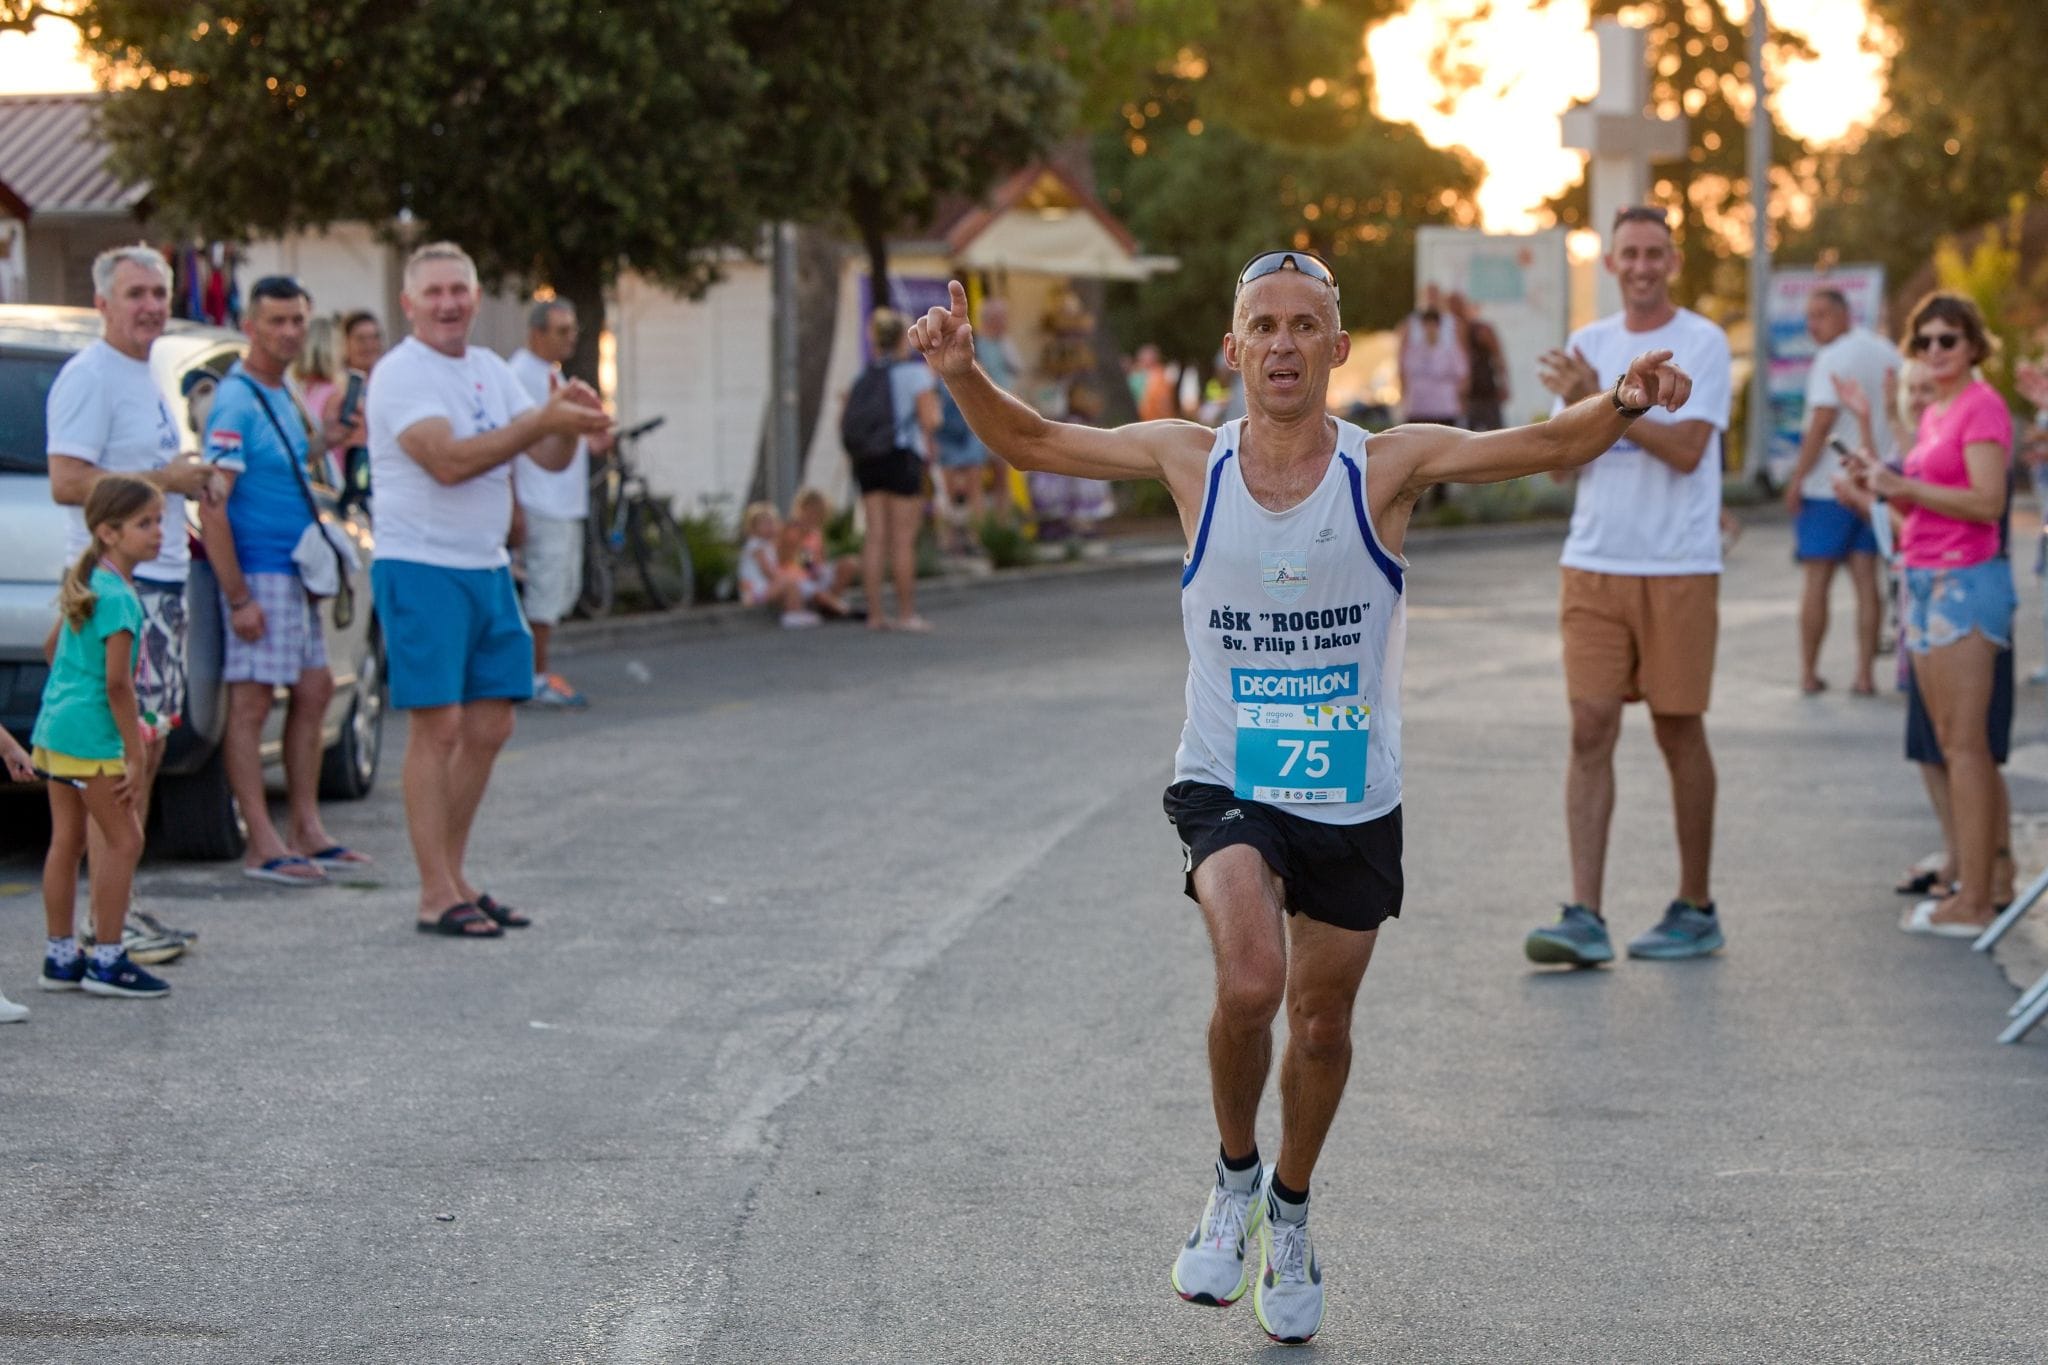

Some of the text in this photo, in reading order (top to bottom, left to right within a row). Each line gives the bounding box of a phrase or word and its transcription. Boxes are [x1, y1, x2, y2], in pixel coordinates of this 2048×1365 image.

[1208, 605, 1252, 632] AŠK
[1222, 632, 1362, 655] Sv. Filip i Jakov
[1239, 671, 1350, 697] DECATHLON
[1277, 739, 1330, 778] 75
